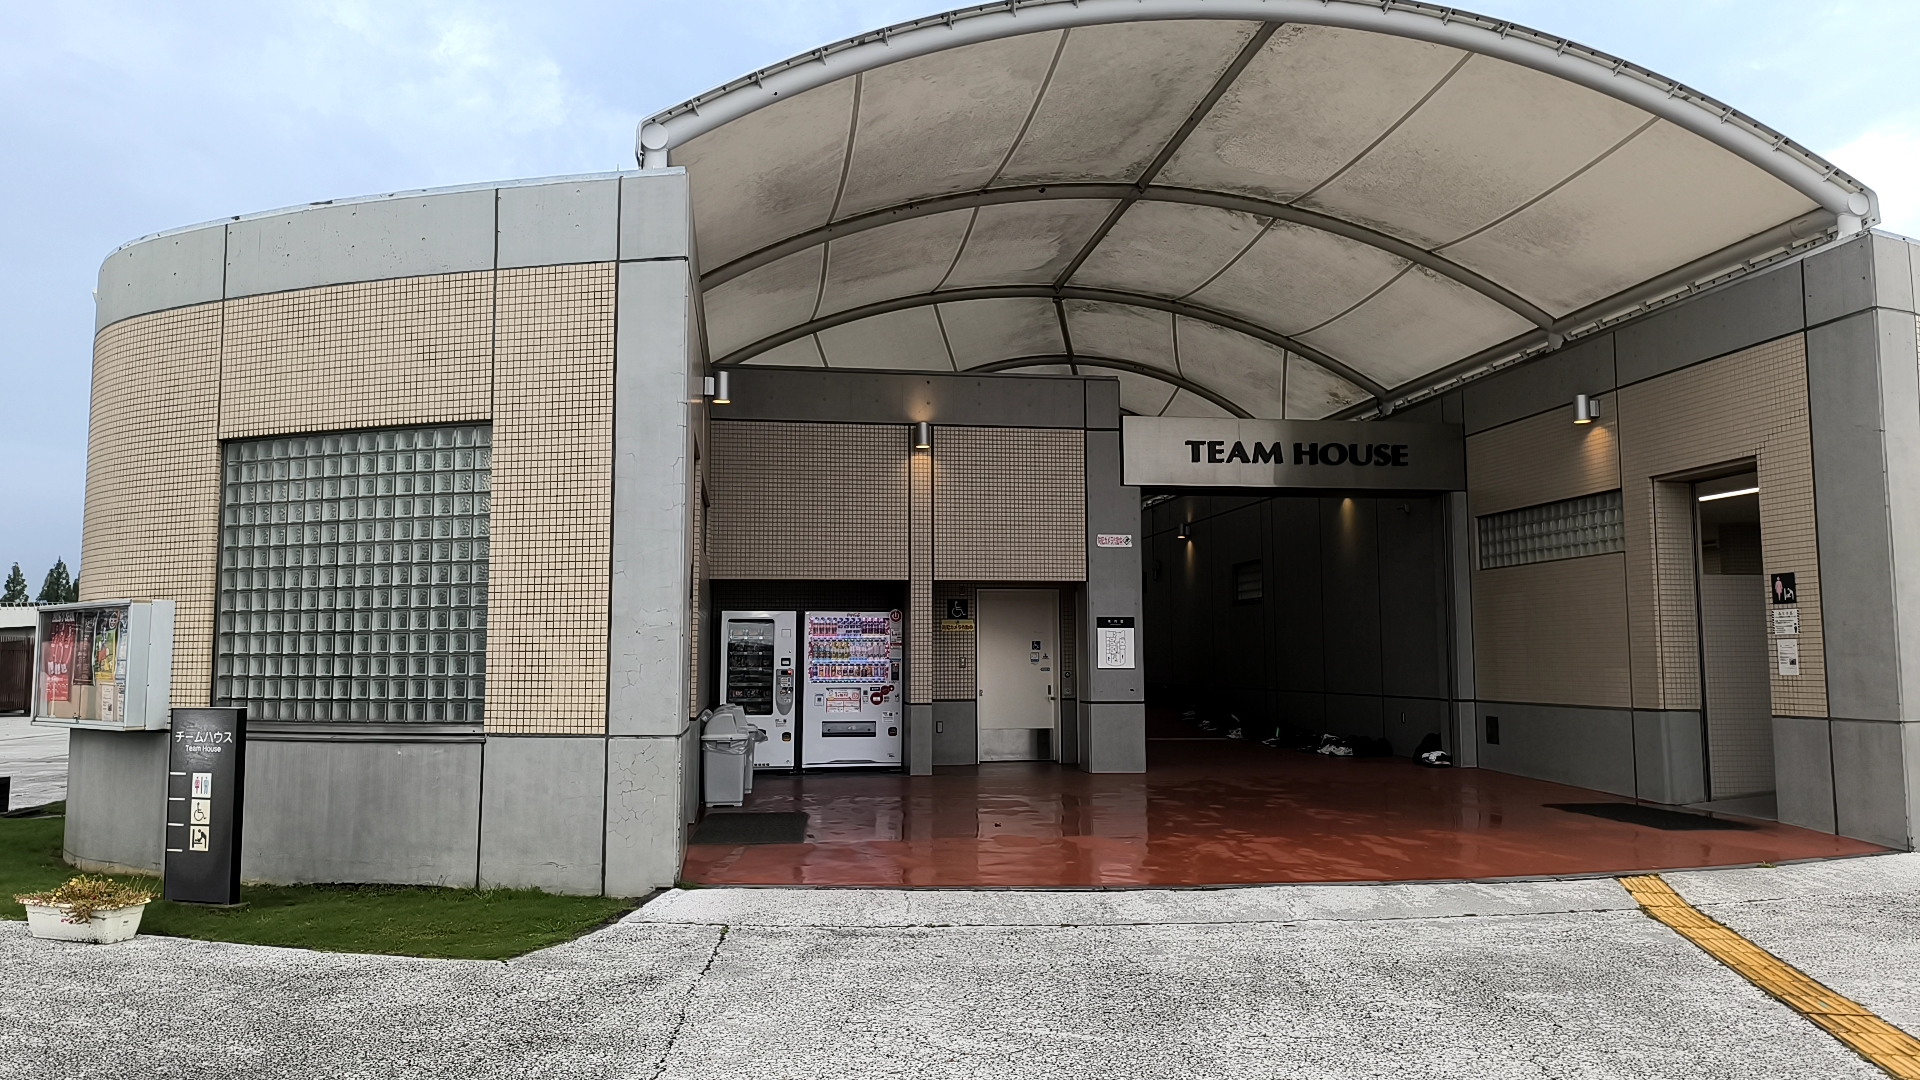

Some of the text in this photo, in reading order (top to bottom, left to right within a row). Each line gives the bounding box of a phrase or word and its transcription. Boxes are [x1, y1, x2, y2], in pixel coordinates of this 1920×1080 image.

[1185, 440, 1409, 466] TEAM HOUSE
[175, 731, 233, 743] チームハウス
[185, 744, 222, 753] Team House
